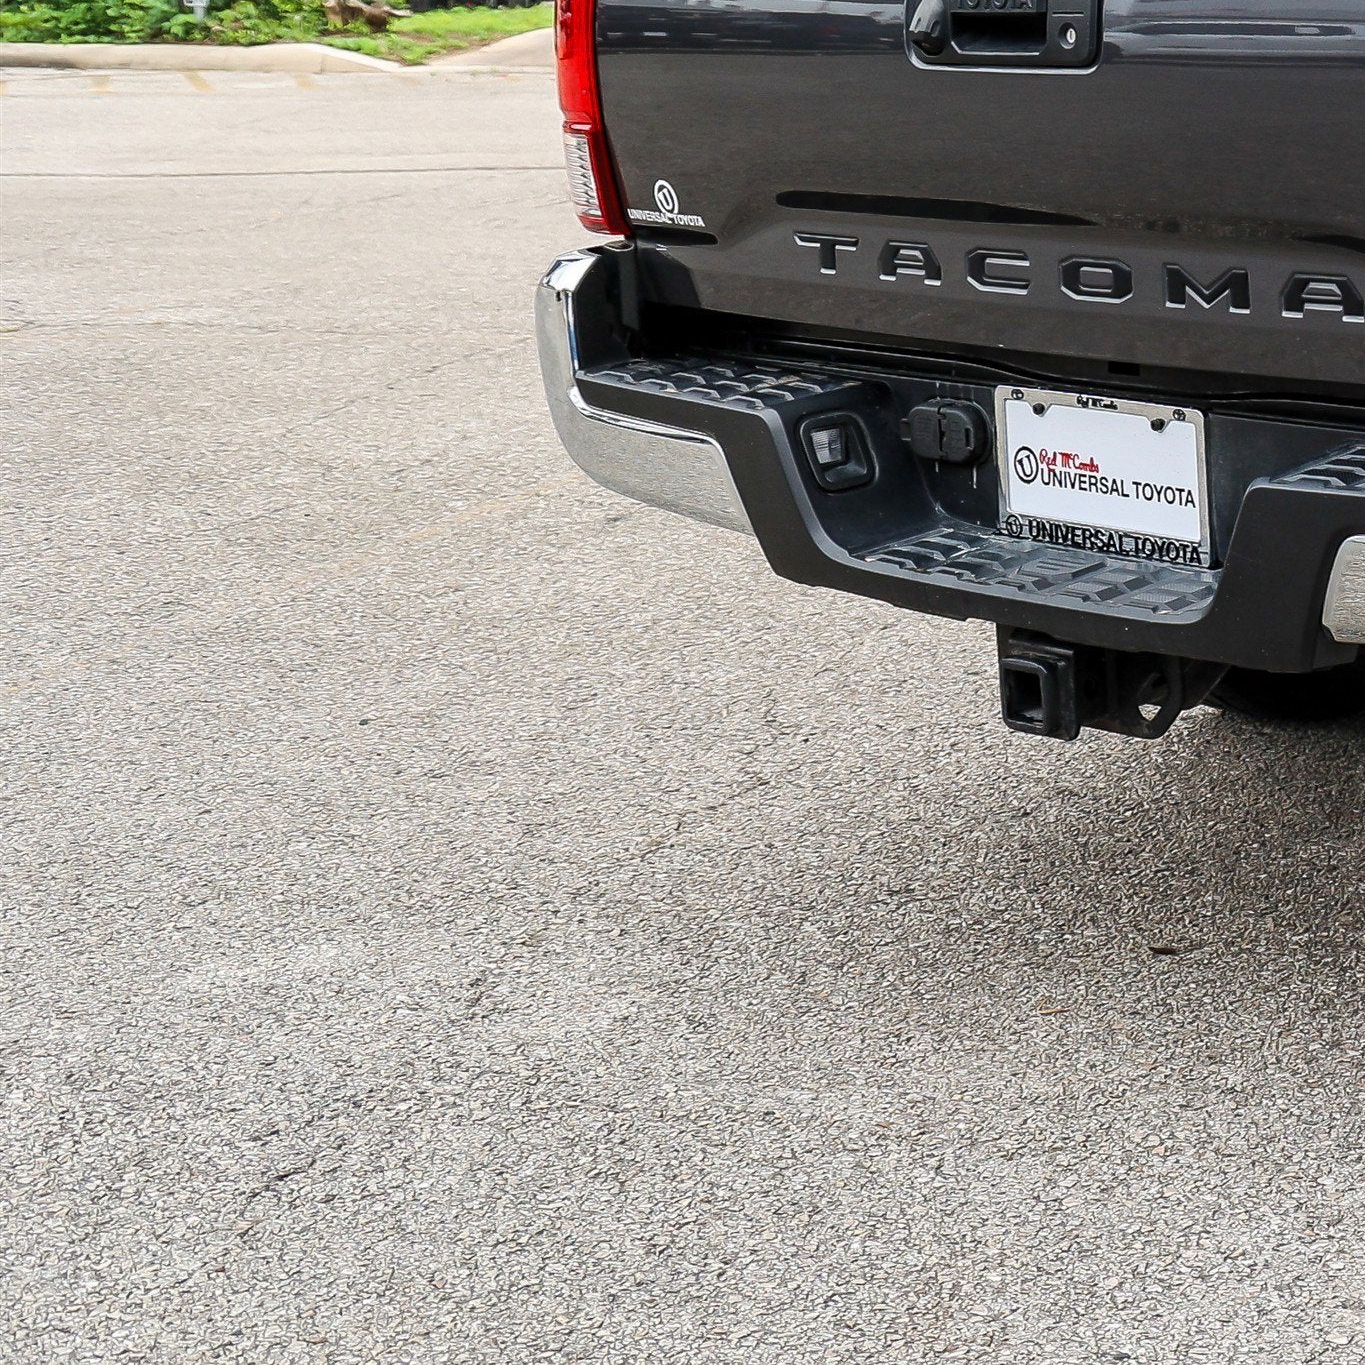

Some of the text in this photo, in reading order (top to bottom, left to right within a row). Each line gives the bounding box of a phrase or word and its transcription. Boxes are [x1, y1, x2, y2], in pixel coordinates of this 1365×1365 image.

[627, 208, 706, 227] UNIVERSAL TOYOTA
[793, 232, 1365, 323] TACOMA
[1041, 467, 1197, 509] UNIVERSAL TOYOTA
[1028, 518, 1202, 565] UNIVERSAL TOYOTA
